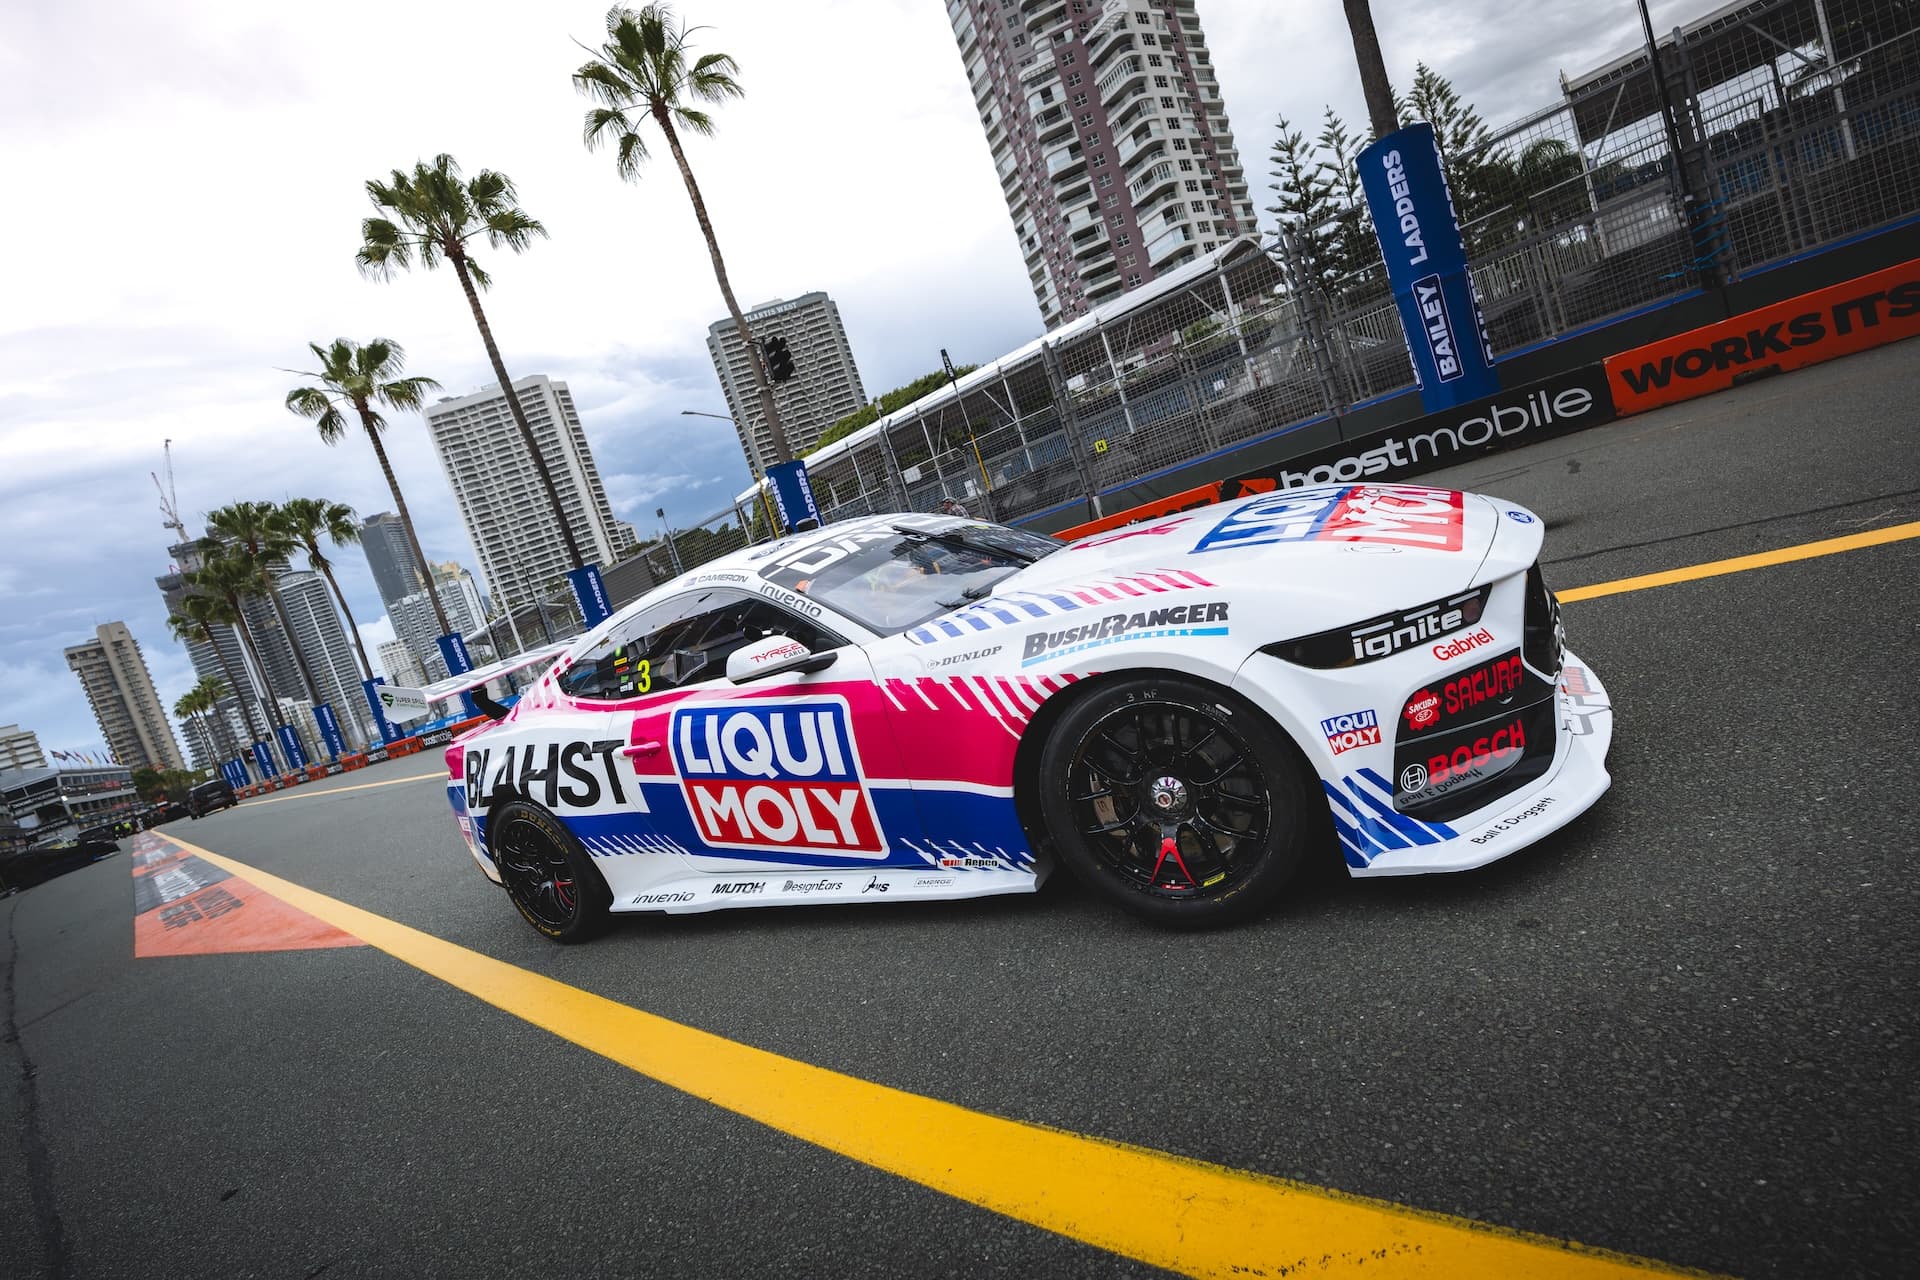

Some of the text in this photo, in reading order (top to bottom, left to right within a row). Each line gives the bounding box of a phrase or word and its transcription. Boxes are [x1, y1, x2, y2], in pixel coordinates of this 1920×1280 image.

[1383, 150, 1428, 266] LADDERS
[1417, 285, 1459, 377] BAILEY
[1621, 311, 1826, 394] WORKS
[768, 476, 790, 526] ADDERS
[588, 571, 608, 617] LADDERS
[698, 574, 748, 584] CAMERON
[759, 582, 823, 618] invenio
[1352, 607, 1463, 660] ignite
[1433, 627, 1495, 661] Gabriel
[750, 643, 802, 663] TYREE
[941, 645, 1002, 667] DUNLOP
[637, 660, 651, 692] 3
[1444, 655, 1524, 715] SAKURA
[1408, 696, 1438, 714] SAKURA
[1322, 711, 1376, 737] LIQUI
[1330, 728, 1381, 753] MOLY
[679, 710, 846, 779] LIQUI
[1427, 718, 1527, 785] BOSCH
[465, 738, 627, 809] BLAHST
[692, 784, 873, 846] MOLY
[1471, 828, 1494, 846] Ball
[1509, 796, 1557, 826] Doggett
[964, 858, 999, 867] Repco
[632, 891, 696, 904] invenio
[711, 881, 767, 895] MUTOH
[782, 879, 844, 894] DesignEars
